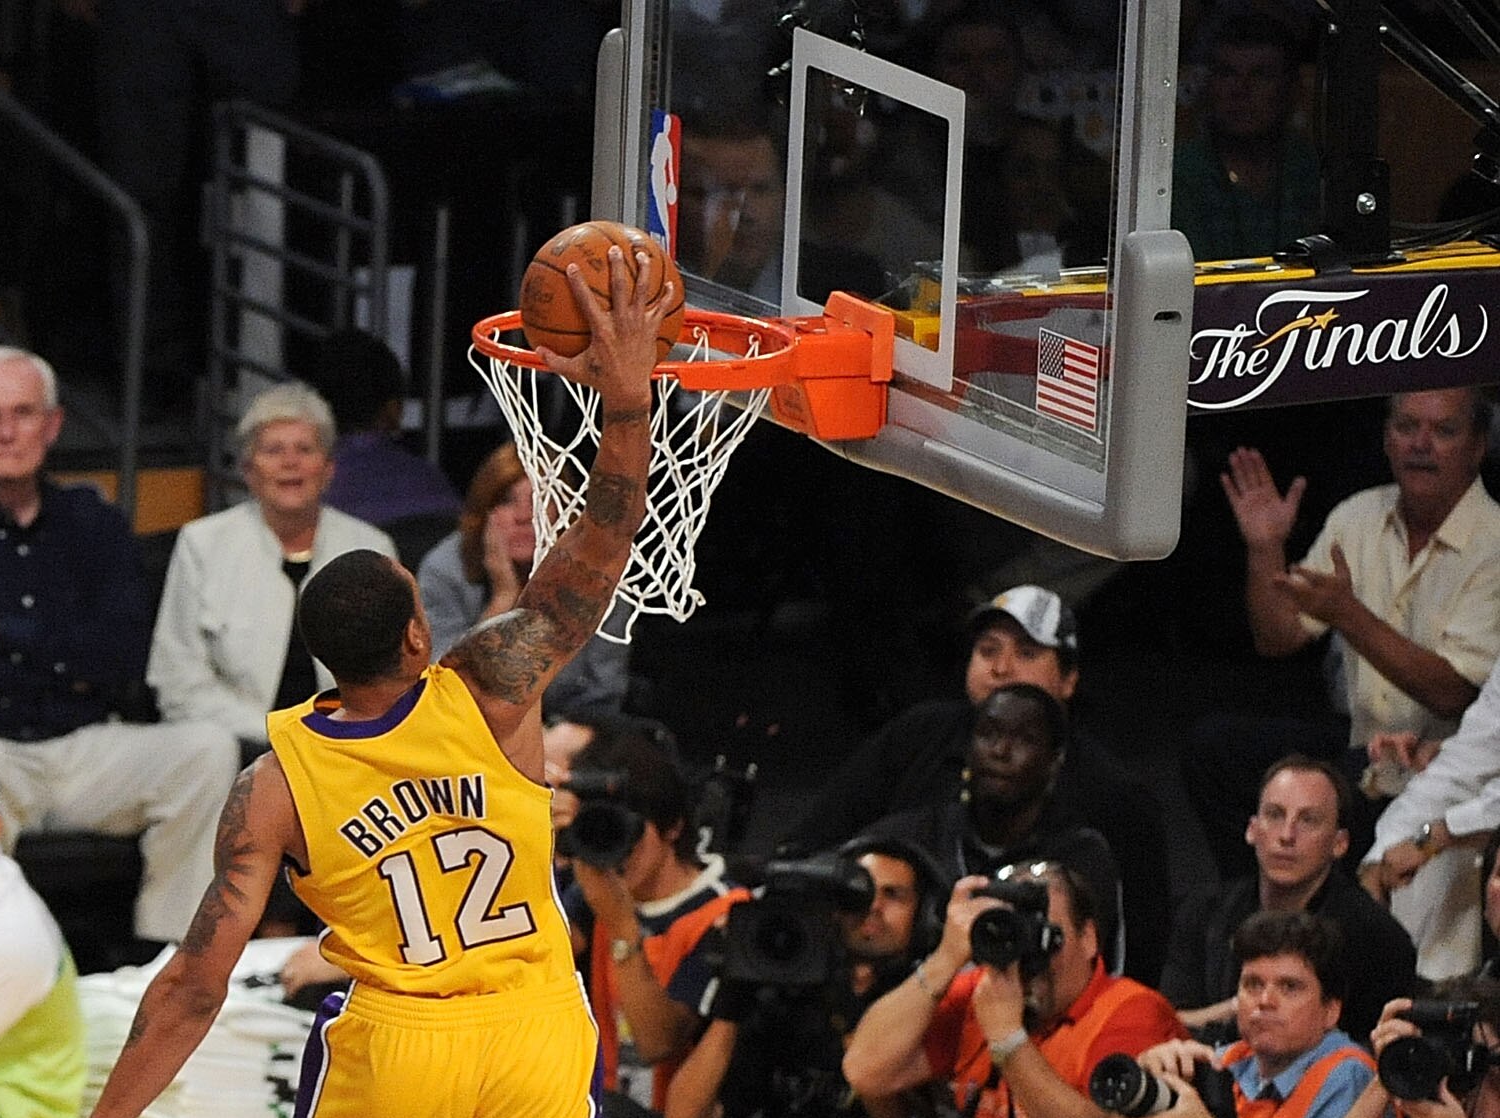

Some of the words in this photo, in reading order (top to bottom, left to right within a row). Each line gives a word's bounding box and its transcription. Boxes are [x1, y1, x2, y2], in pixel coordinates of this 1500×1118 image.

[1187, 284, 1488, 410] Finals
[1188, 323, 1269, 385] The
[339, 774, 486, 860] BROWN
[375, 825, 538, 968] 12
